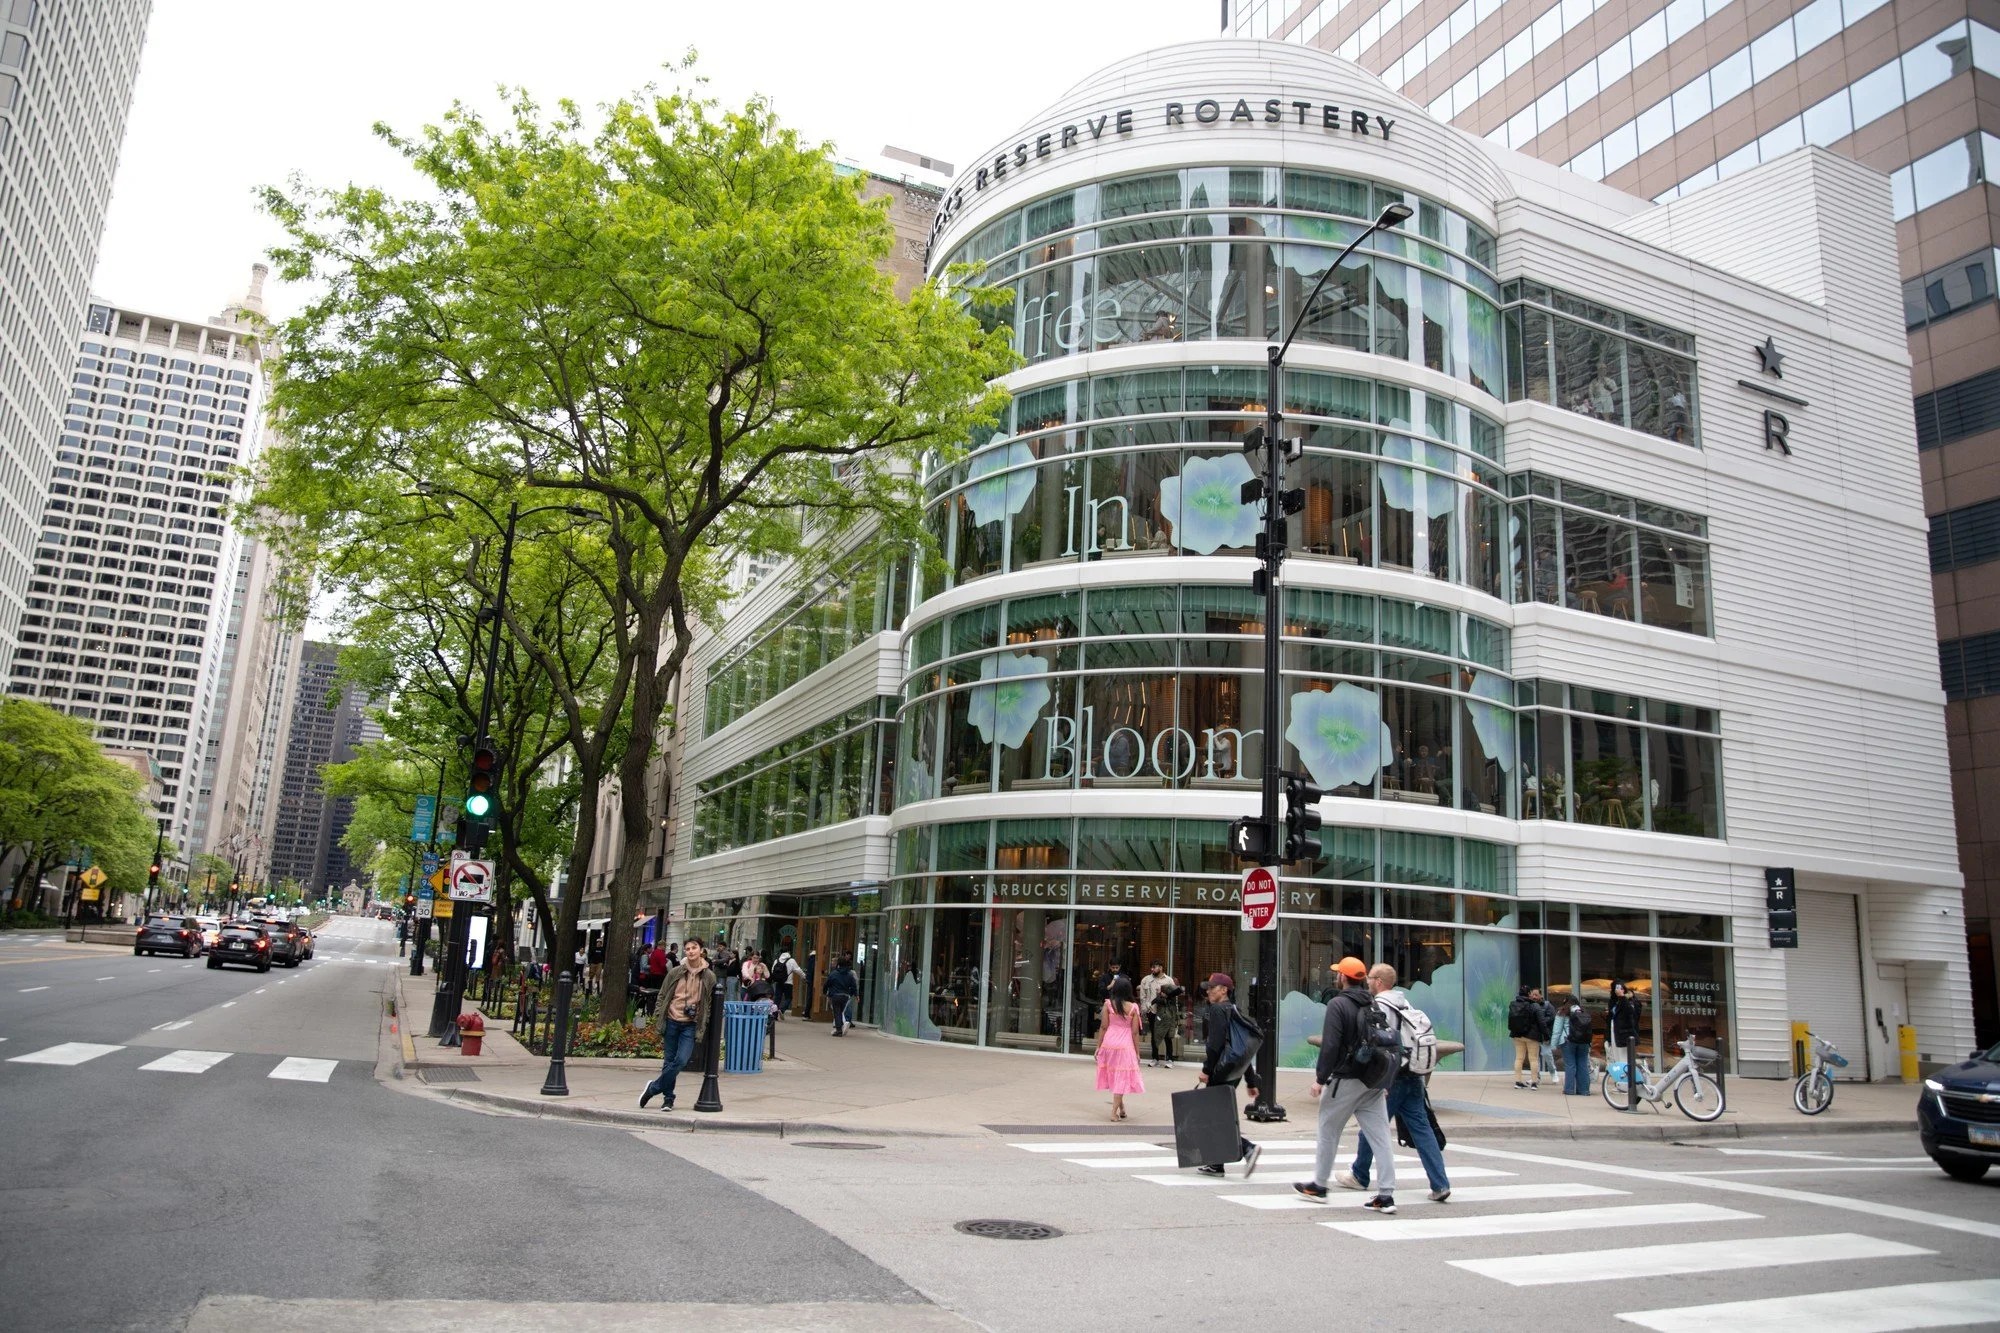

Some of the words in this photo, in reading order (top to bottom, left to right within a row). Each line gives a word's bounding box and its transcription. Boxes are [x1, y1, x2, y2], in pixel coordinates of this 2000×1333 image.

[976, 109, 1133, 191] RESERVE
[1166, 99, 1396, 141] ROASTERY
[1764, 409, 1792, 455] R
[1061, 486, 1136, 557] In
[1040, 705, 1264, 781] Bloom
[1247, 881, 1256, 891] DO
[1259, 880, 1272, 890] NOT
[1081, 884, 1181, 900] RESERVE
[1197, 887, 1316, 906] ROAERY
[1776, 891, 1784, 900] R
[1249, 907, 1269, 917] ENTER
[1673, 981, 1720, 991] STARBUCKS
[1673, 994, 1712, 1003] RESERVE
[1674, 1006, 1718, 1016] ROASTERY
